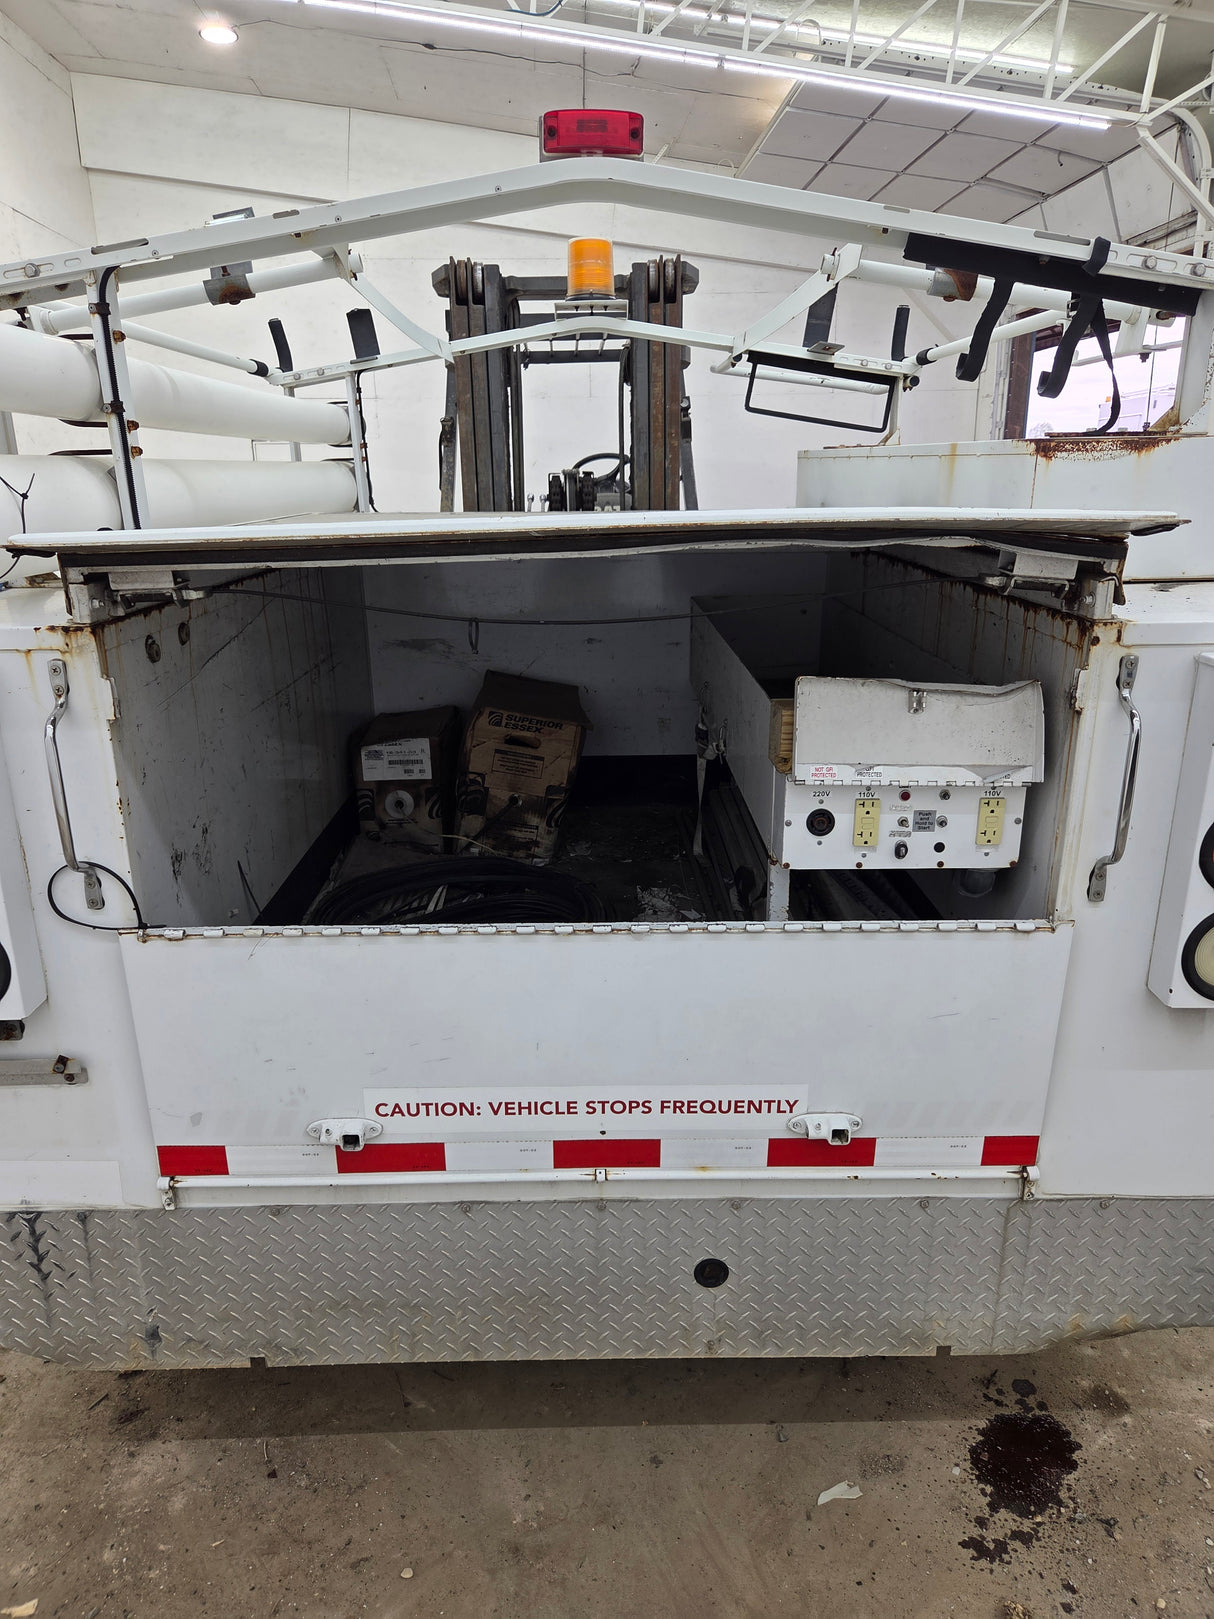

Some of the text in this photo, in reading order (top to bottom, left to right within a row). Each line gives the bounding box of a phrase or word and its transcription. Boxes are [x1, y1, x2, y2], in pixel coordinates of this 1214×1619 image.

[503, 722, 545, 734] ESSEX
[504, 714, 564, 730] SUPERIOR
[812, 790, 831, 798] 220V
[858, 791, 876, 799] 110V
[374, 1099, 800, 1118] CAUTION: VEHICLE STOPS FREQUENTLY
